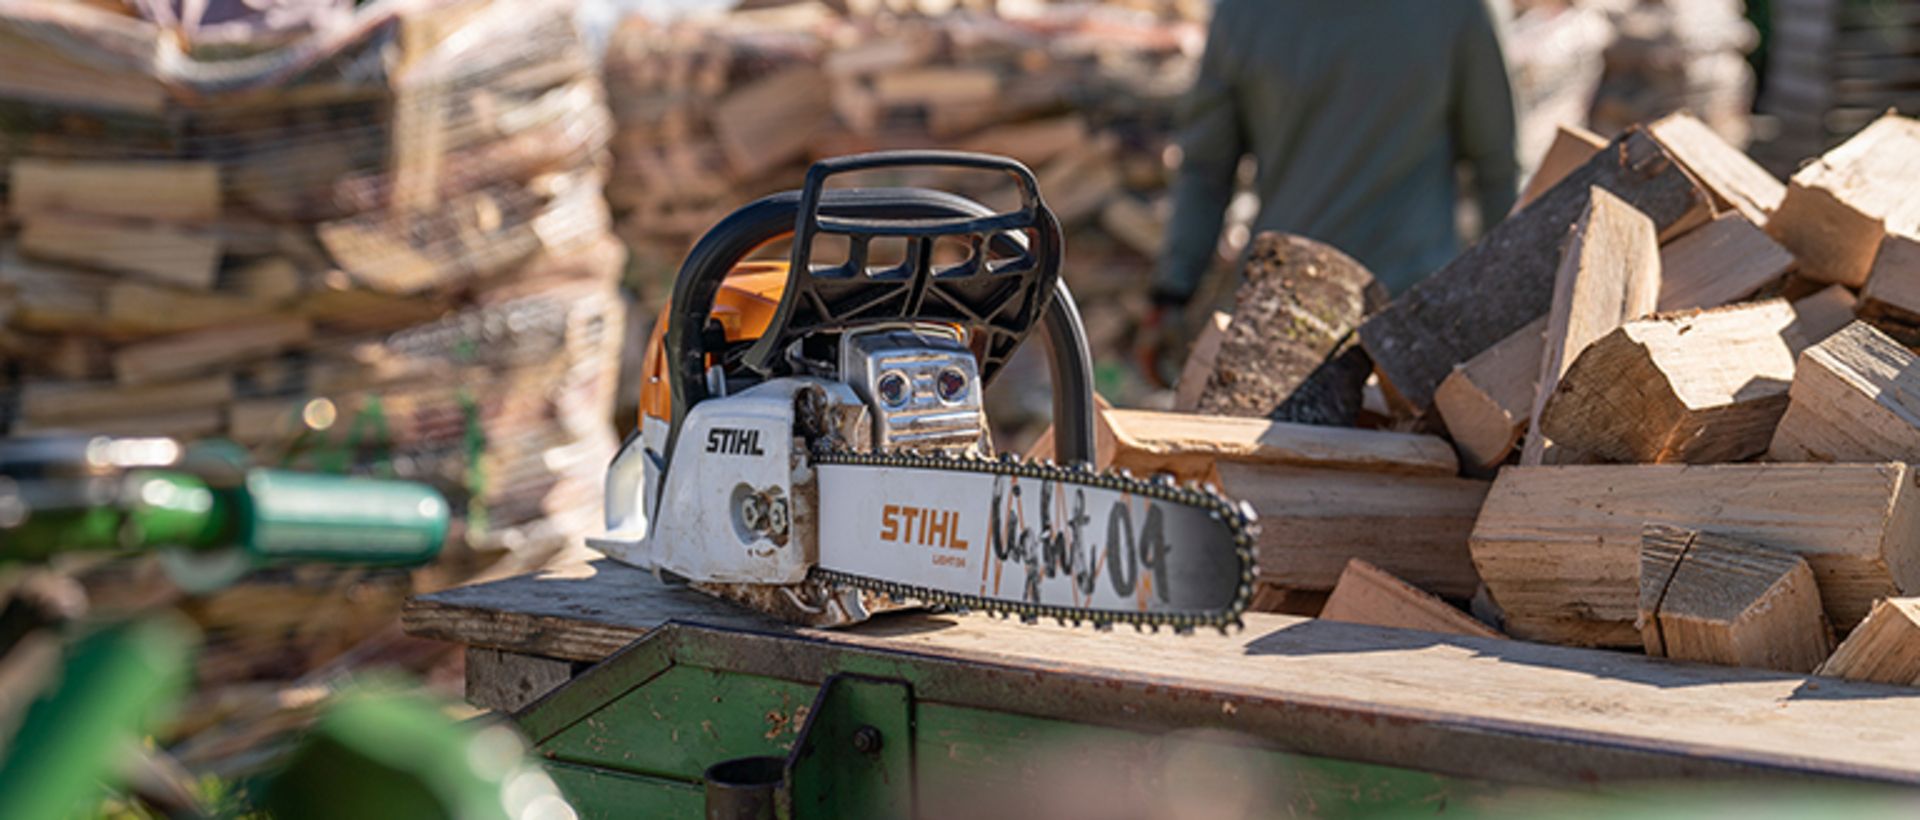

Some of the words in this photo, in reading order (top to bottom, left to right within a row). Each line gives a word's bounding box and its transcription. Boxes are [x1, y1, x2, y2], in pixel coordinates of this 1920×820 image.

[706, 427, 764, 456] STIHL
[880, 504, 969, 551] STIHL
[1107, 501, 1172, 604] 04
